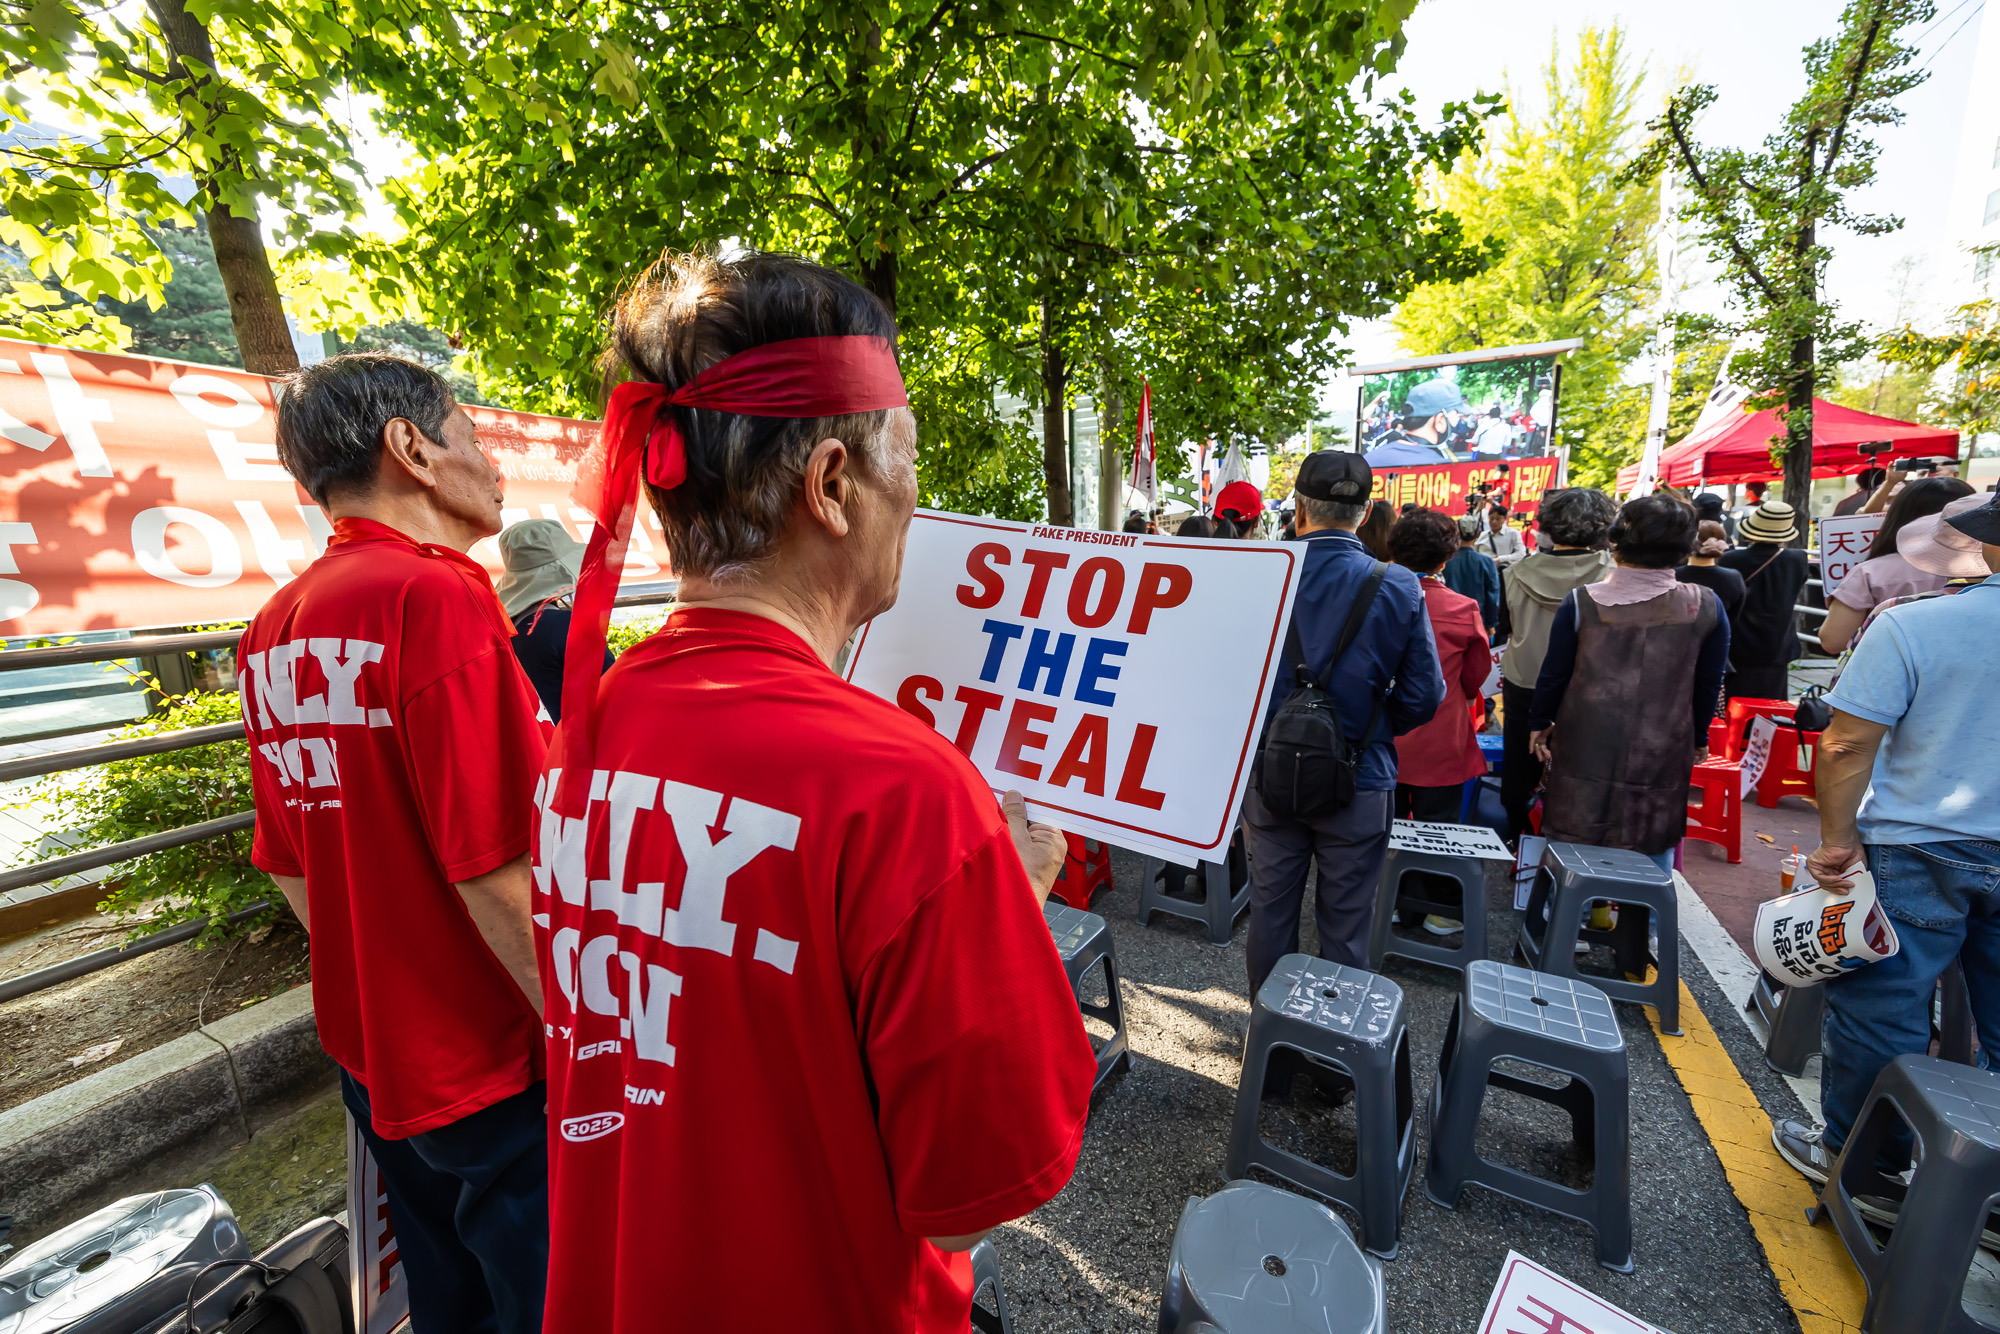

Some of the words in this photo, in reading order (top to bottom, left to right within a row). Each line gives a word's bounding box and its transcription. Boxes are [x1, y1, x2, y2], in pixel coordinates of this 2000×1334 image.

[1032, 526, 1063, 540] FAKE
[1065, 530, 1138, 548] PRESIDENT
[955, 542, 1193, 635] STOP
[979, 618, 1130, 707] THE
[896, 674, 1166, 811] STEAL
[1390, 834, 1419, 844] Ent
[1400, 842, 1476, 856] Chinese
[1422, 824, 1489, 836] Security
[1423, 837, 1502, 852] NO-Visa
[531, 768, 801, 975] NLY.
[1772, 916, 1813, 978] 관광객
[1817, 901, 1856, 957] 반대
[567, 1116, 613, 1136] 2025
